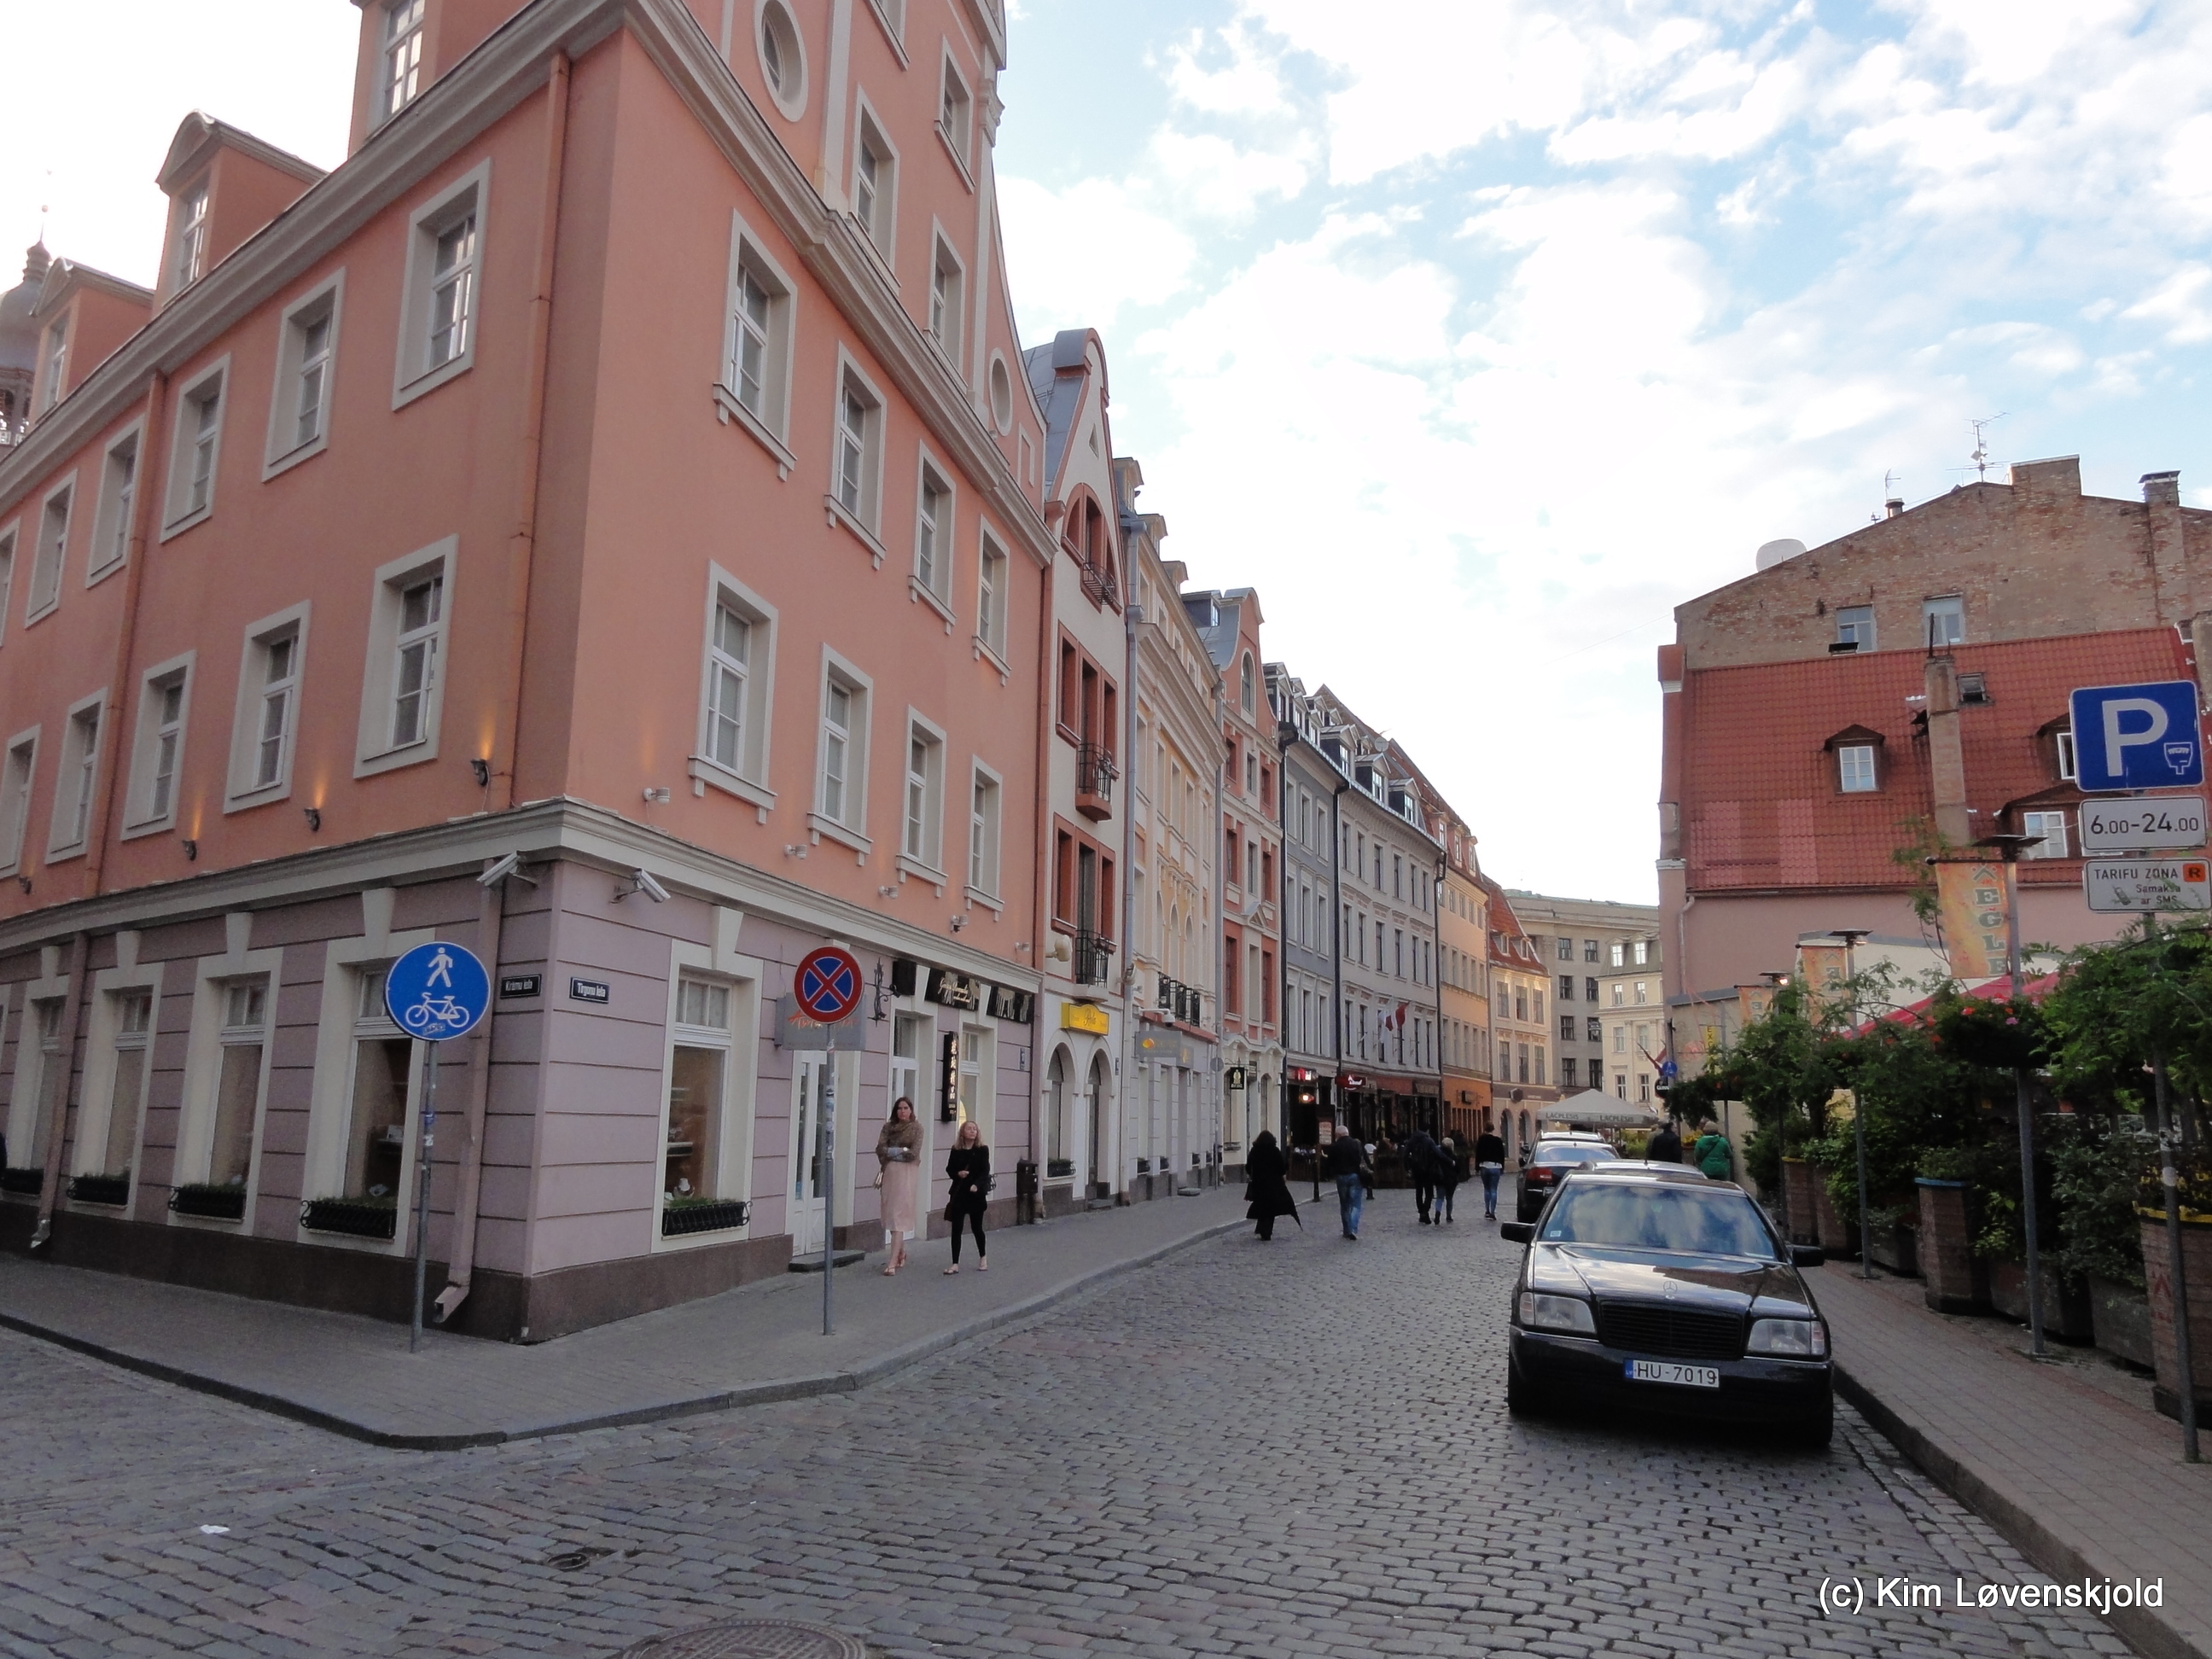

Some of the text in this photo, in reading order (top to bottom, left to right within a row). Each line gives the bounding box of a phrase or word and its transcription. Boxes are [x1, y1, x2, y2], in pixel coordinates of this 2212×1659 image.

[2102, 698, 2168, 777] P
[2093, 867, 2201, 880] TARIFU ZONA R
[2156, 895, 2178, 905] SMS
[1973, 887, 2005, 975] EGLE
